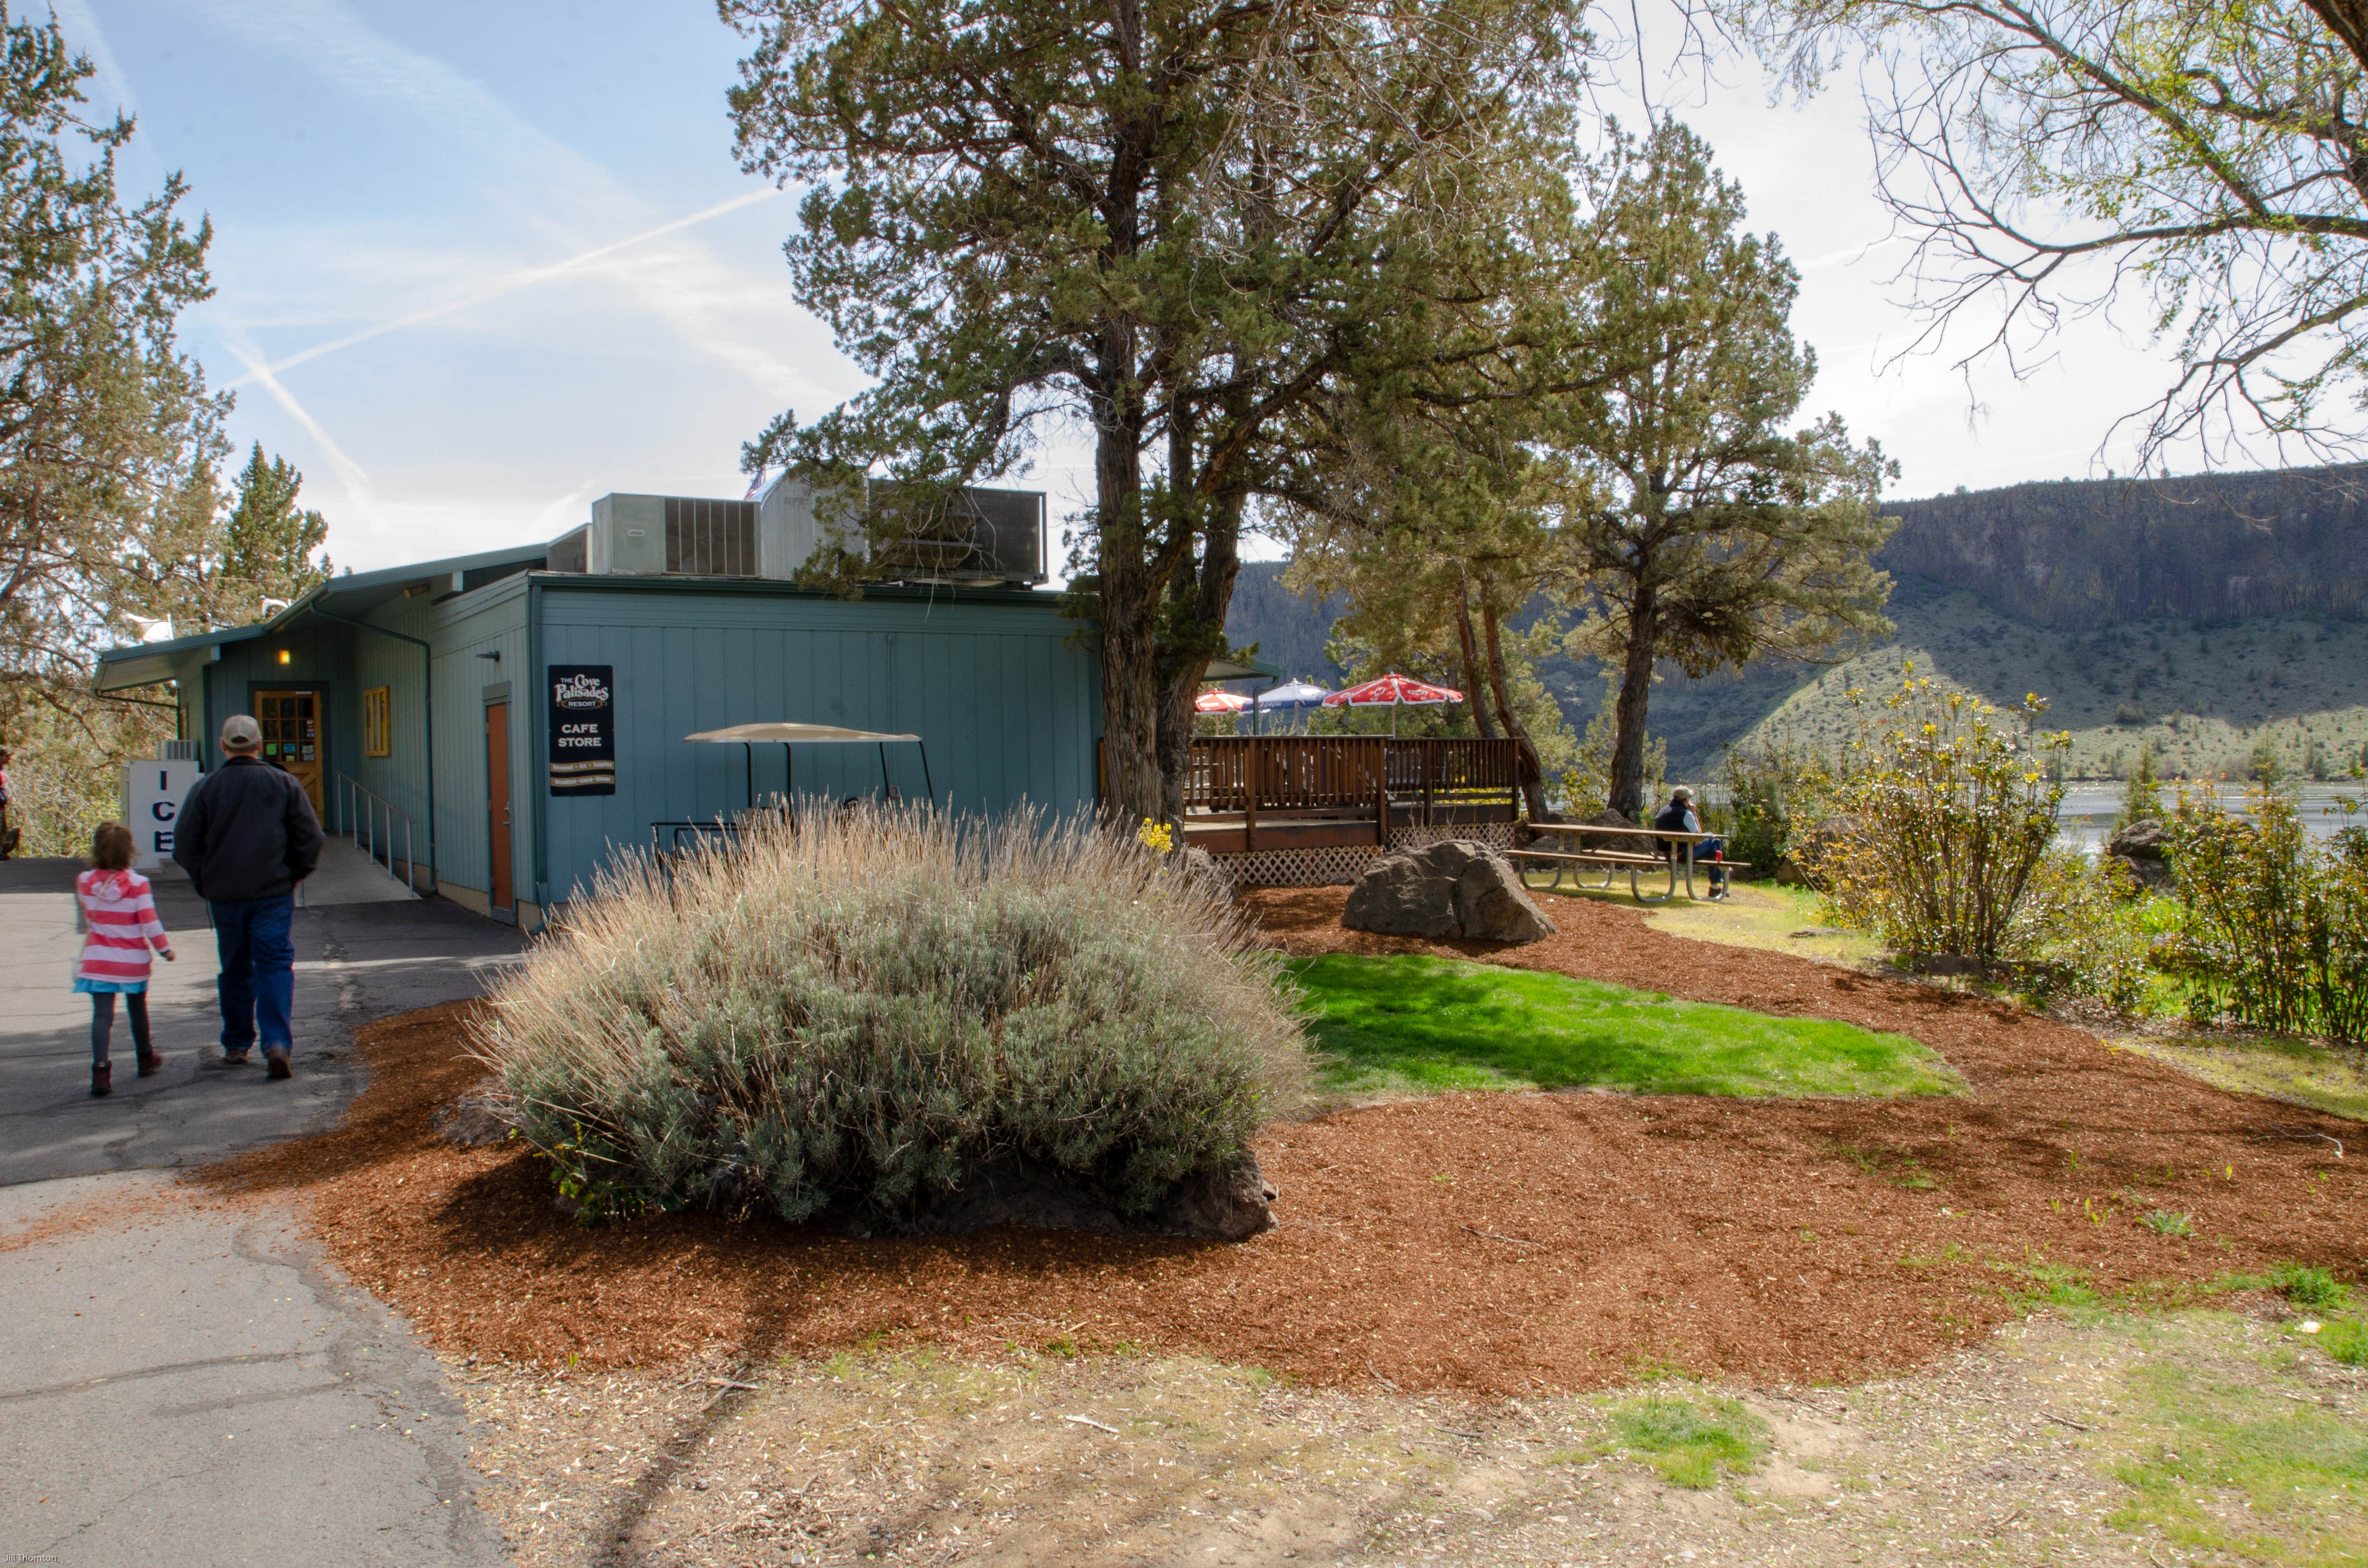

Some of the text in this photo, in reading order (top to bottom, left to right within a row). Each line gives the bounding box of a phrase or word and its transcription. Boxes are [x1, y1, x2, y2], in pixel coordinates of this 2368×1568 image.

[574, 674, 600, 689] Cove
[554, 684, 609, 702] Palisades
[561, 723, 598, 734] CAFE
[558, 737, 602, 747] STORE
[152, 770, 175, 852] ICE
